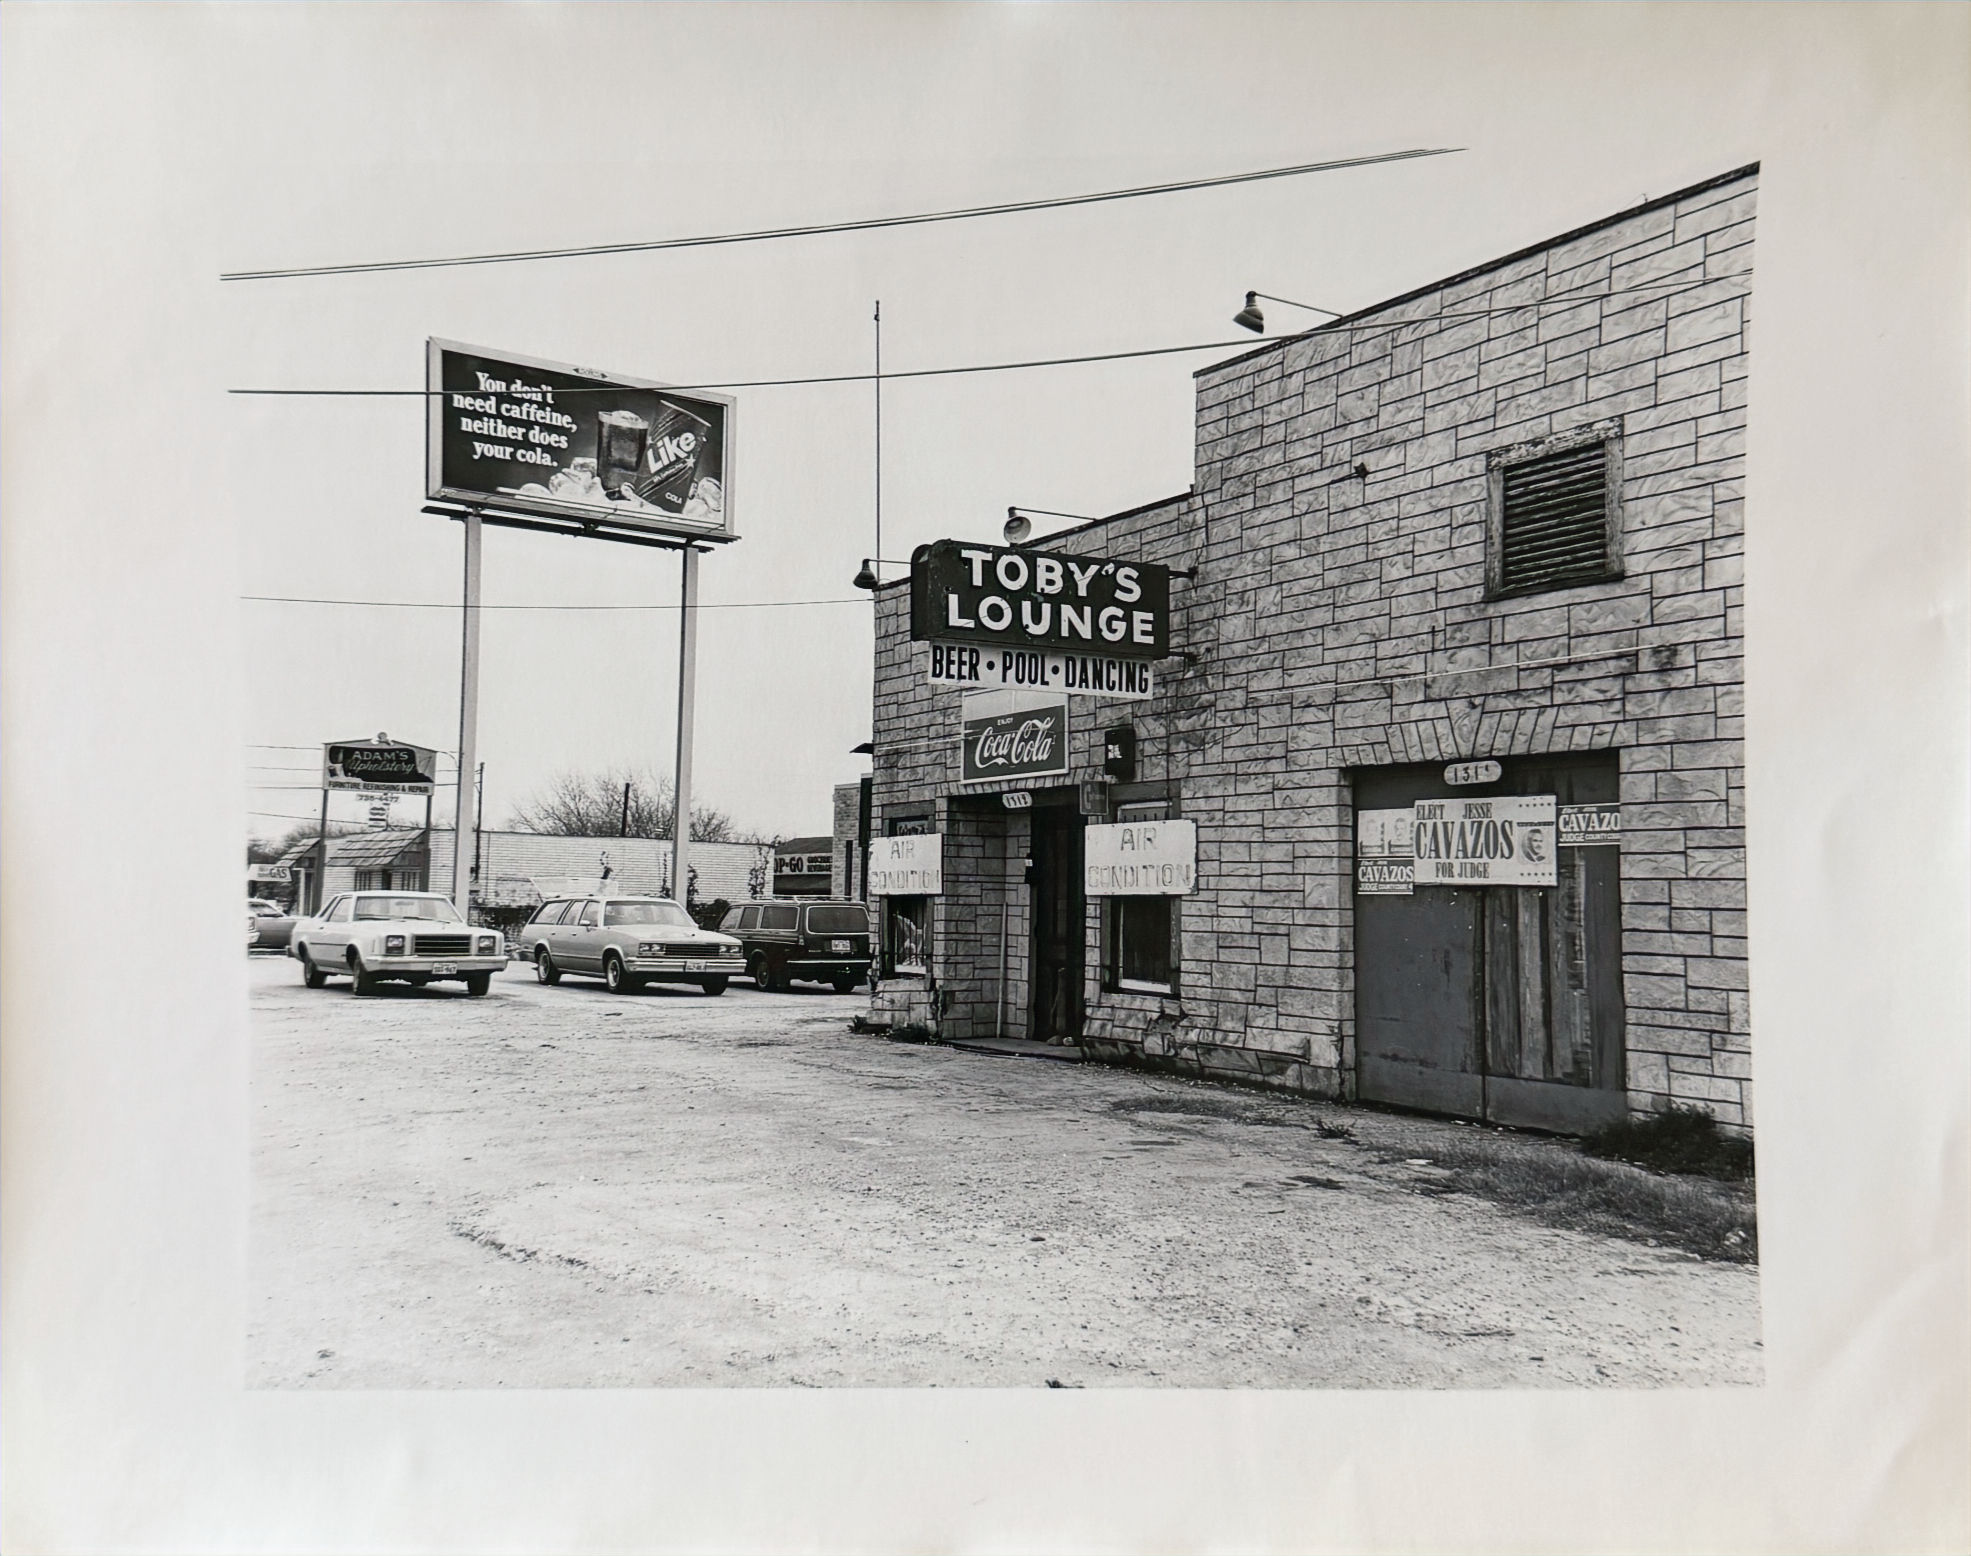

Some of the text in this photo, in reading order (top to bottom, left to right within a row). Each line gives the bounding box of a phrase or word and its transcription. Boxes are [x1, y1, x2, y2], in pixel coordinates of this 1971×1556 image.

[476, 371, 554, 404] You don't
[453, 394, 577, 433] need caffeine,
[460, 417, 568, 449] neither does
[472, 441, 558, 467] your cola.
[647, 432, 696, 474] Like
[961, 549, 1142, 602] TOBY'S
[948, 594, 1155, 645] LOUNGE
[931, 645, 1149, 693] BEER POOL DANCING
[352, 750, 409, 761] ADAM'S
[1416, 802, 1492, 820] ELECT JESSE
[890, 840, 915, 860] AIR
[1121, 827, 1158, 851] AIR
[1415, 820, 1514, 860] CAVAZOS
[1087, 863, 1191, 889] CONDITION
[1359, 865, 1414, 882] CAVAZOS
[1435, 862, 1489, 879] FOR JUDGE
